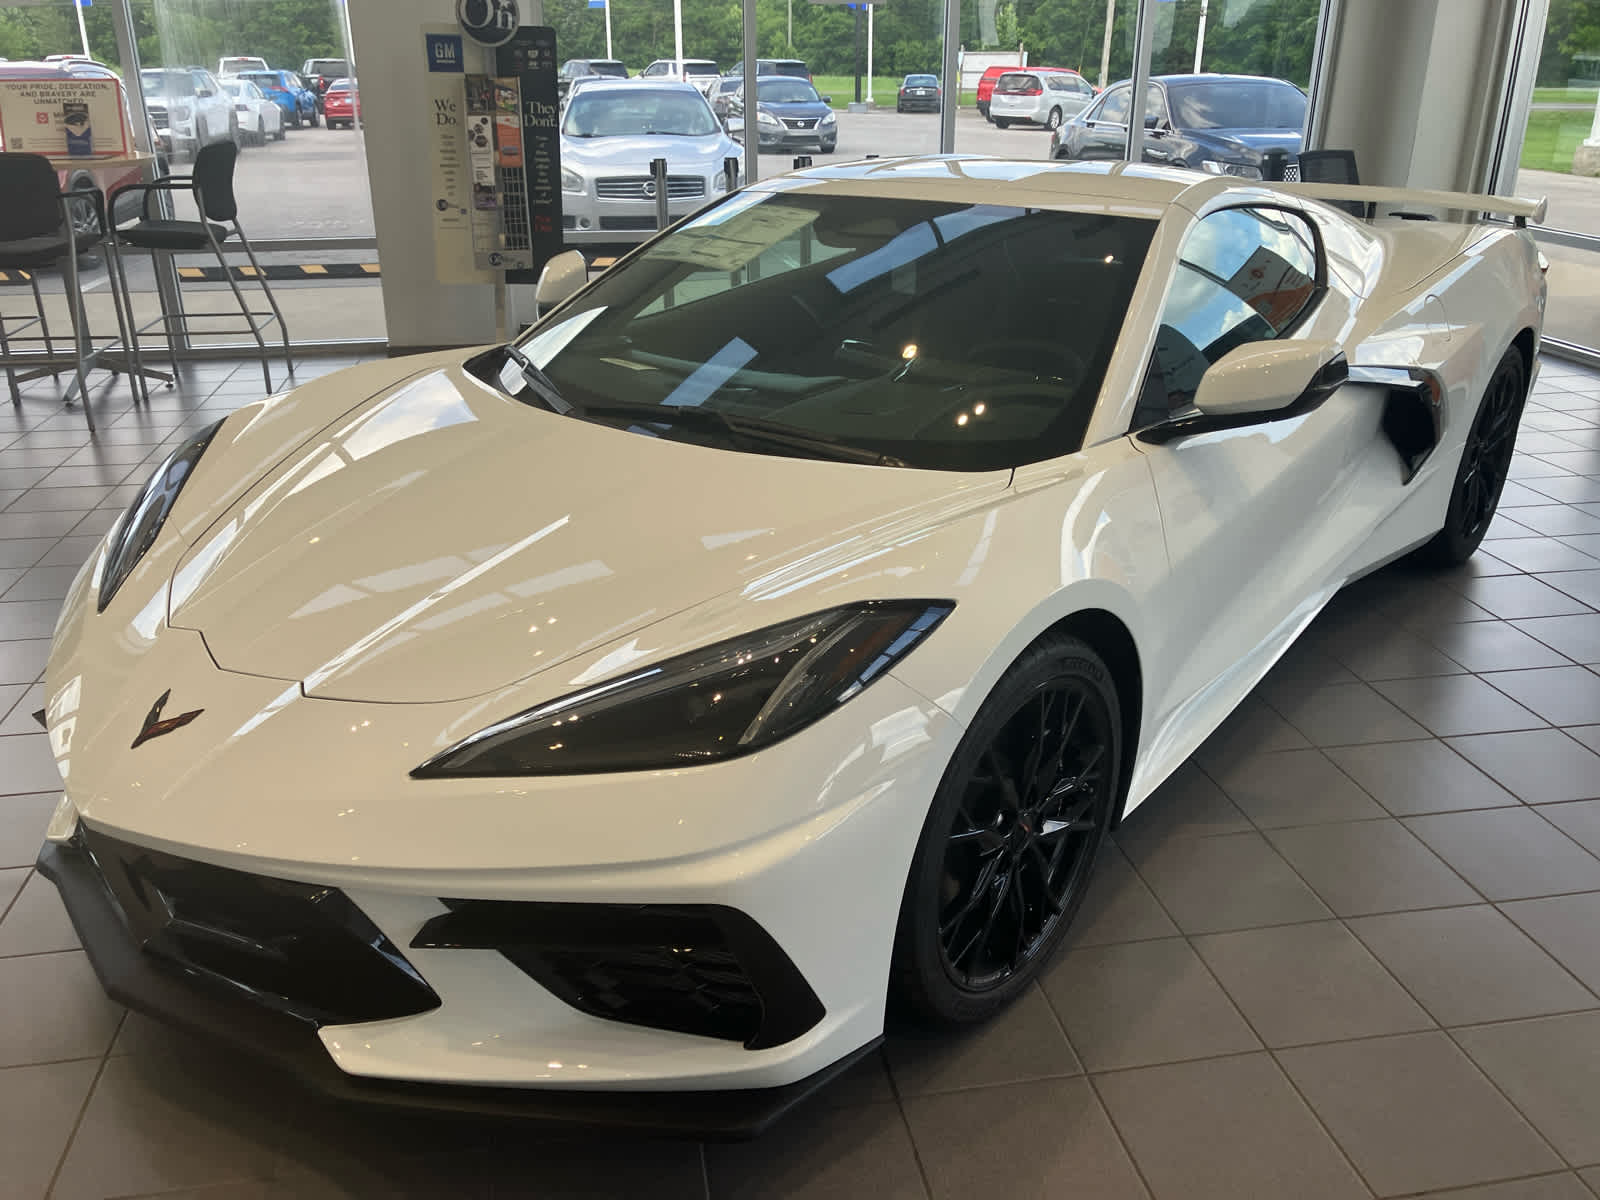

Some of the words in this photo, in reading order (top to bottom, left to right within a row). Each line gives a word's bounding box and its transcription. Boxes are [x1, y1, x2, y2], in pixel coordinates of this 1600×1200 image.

[460, 0, 514, 29] On
[435, 42, 455, 58] GM
[434, 99, 456, 112] We
[526, 101, 557, 115] They
